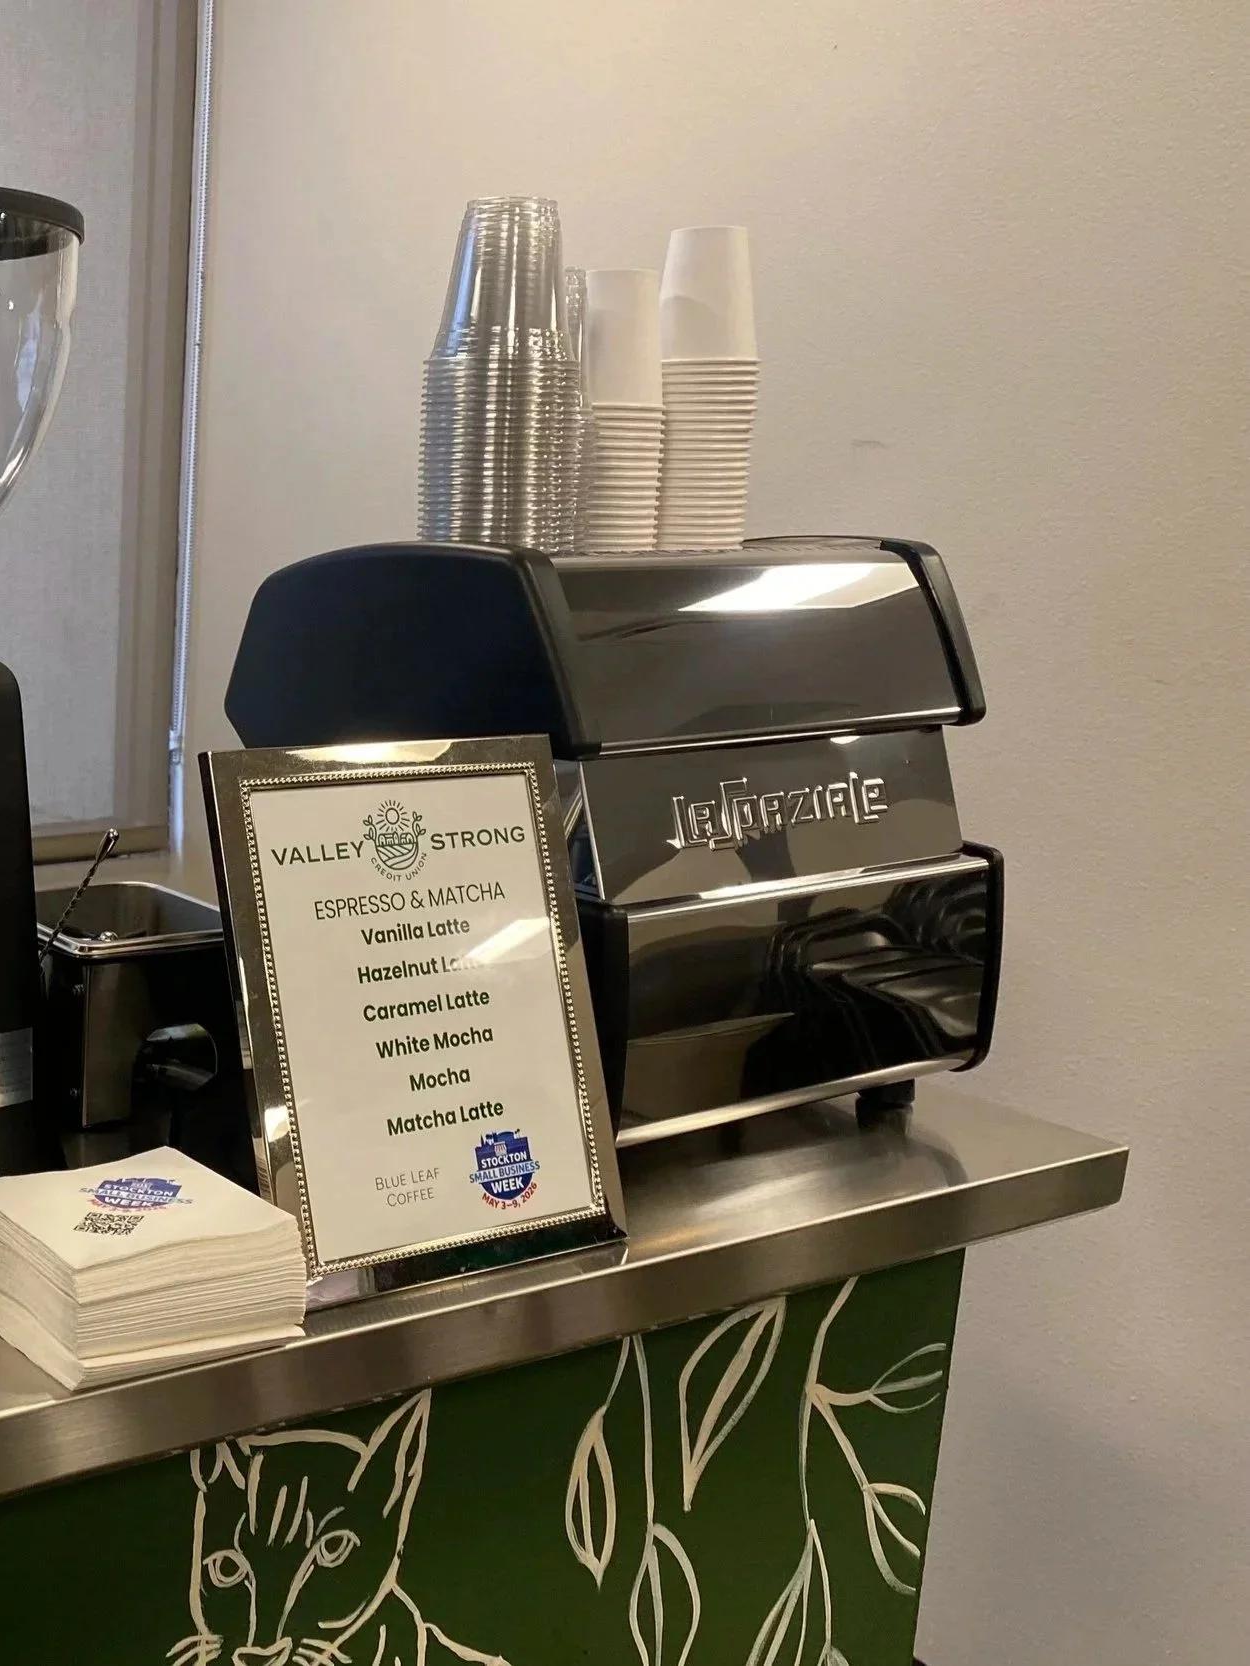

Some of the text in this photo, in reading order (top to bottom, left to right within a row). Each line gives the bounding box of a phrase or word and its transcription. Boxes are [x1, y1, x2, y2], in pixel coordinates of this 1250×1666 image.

[270, 826, 526, 866] VALLEY STRONG
[370, 852, 428, 882] CREDIT UNION
[314, 881, 506, 920] ESPRESSO & MATCHA
[361, 918, 470, 945] Vanilla Latte
[358, 957, 438, 984] Hazelnut
[363, 989, 490, 1022] Caramel Latte
[376, 1027, 493, 1059] White Mocha
[409, 1068, 471, 1091] Mocha
[387, 1101, 504, 1136] Matcha Latte
[469, 1160, 541, 1184] SMALL BUSINESS
[481, 1150, 527, 1169] STOCKTON
[103, 1184, 174, 1196] STOCKTON
[375, 1167, 440, 1191] BLUE LEAF
[491, 1176, 525, 1194] WEEK
[104, 1196, 154, 1207] WEEK
[387, 1187, 434, 1207] COFFEE
[482, 1192, 500, 1208] MAY
[521, 1182, 538, 1203] 2026
